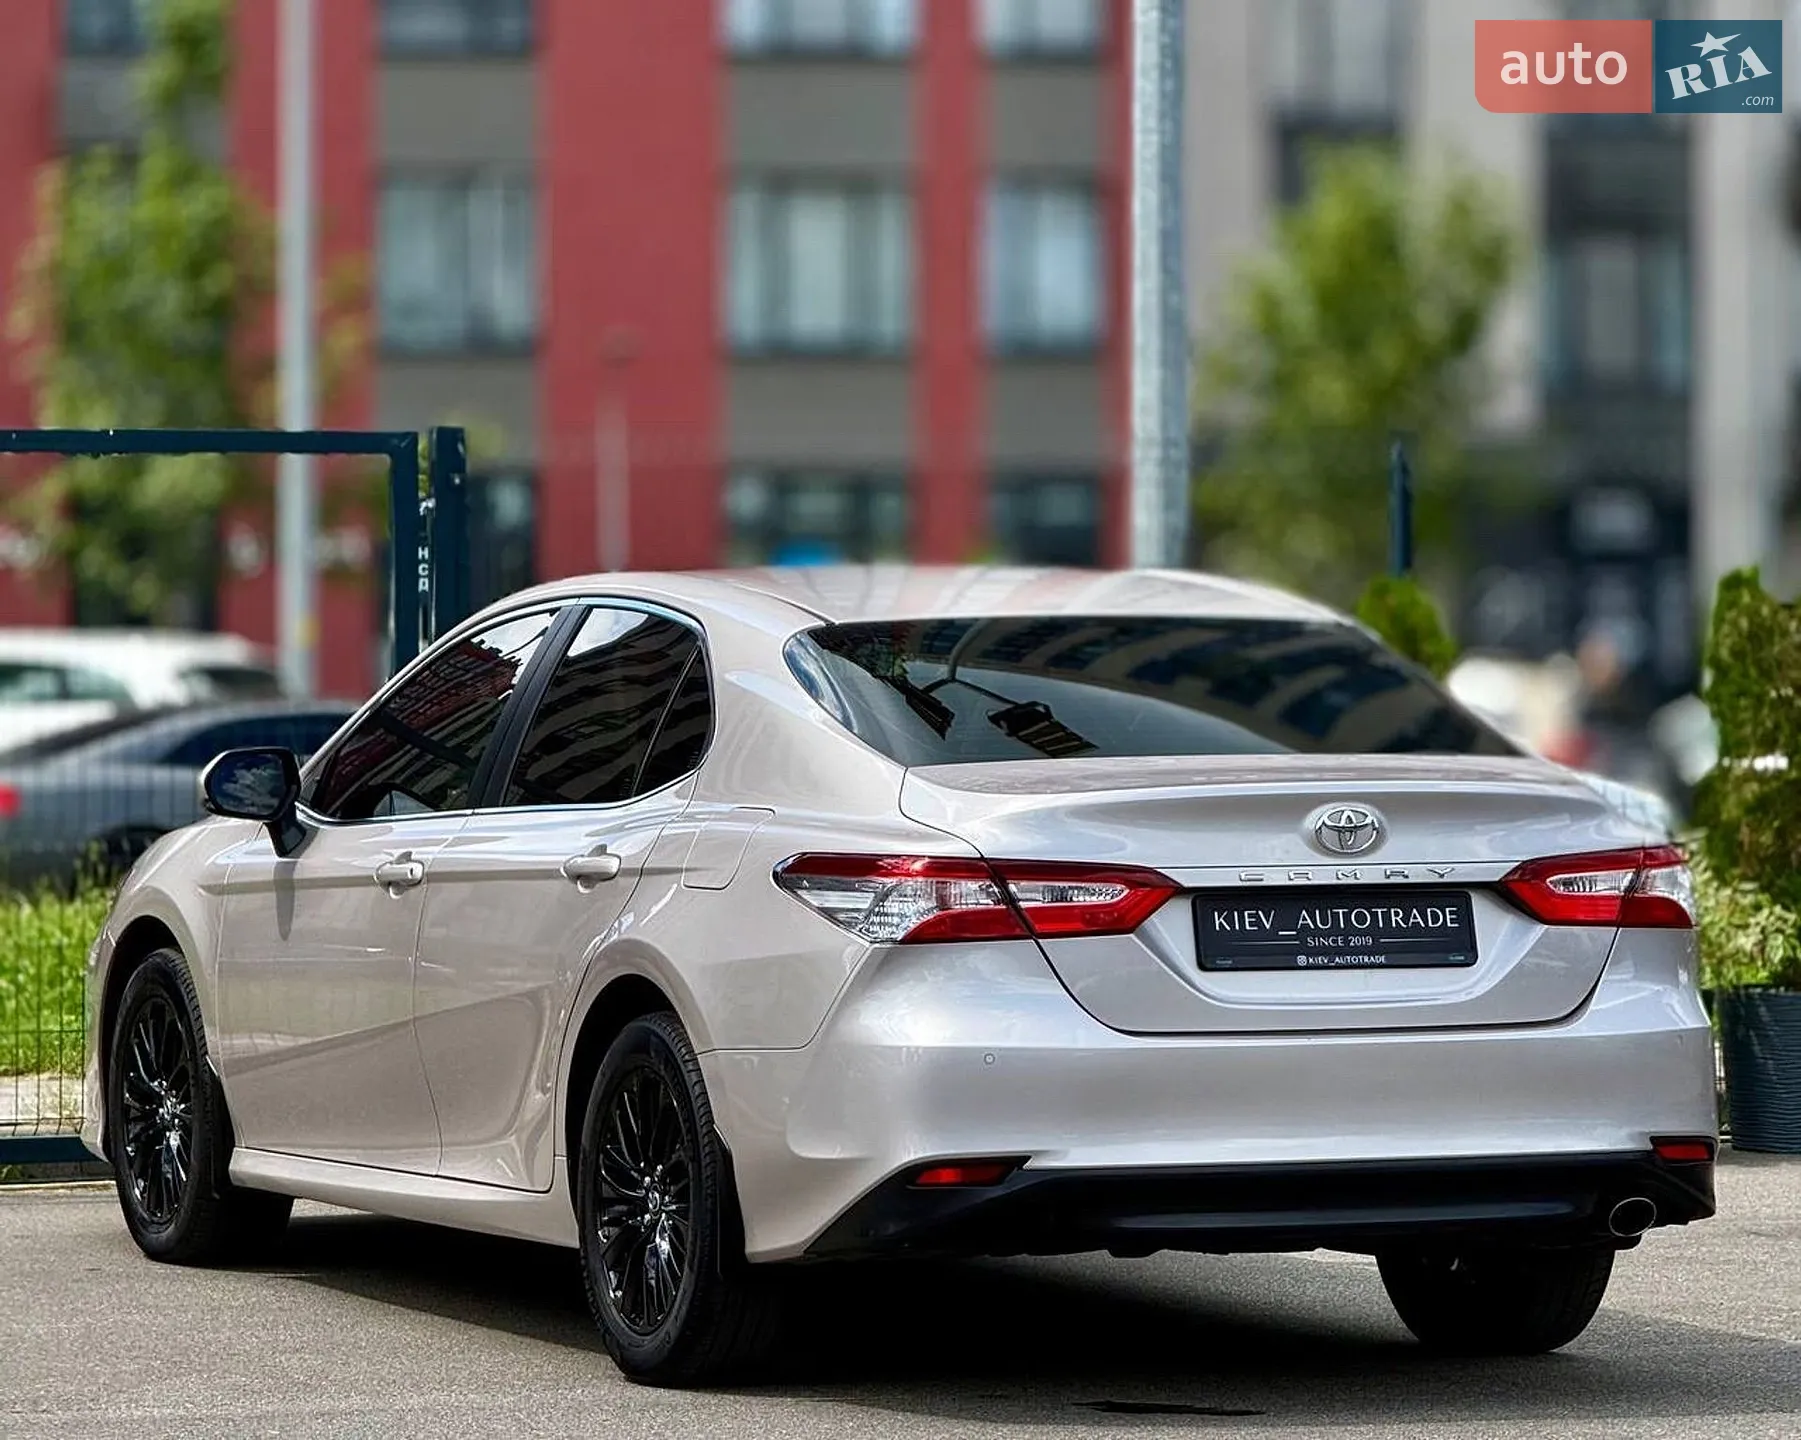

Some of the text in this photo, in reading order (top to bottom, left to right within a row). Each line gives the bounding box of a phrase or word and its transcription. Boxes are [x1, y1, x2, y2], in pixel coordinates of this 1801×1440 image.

[1239, 867, 1455, 882] CAMRY
[1213, 907, 1460, 936] KIEV_AUTOTRADE
[1307, 935, 1373, 947] SINCE 2019
